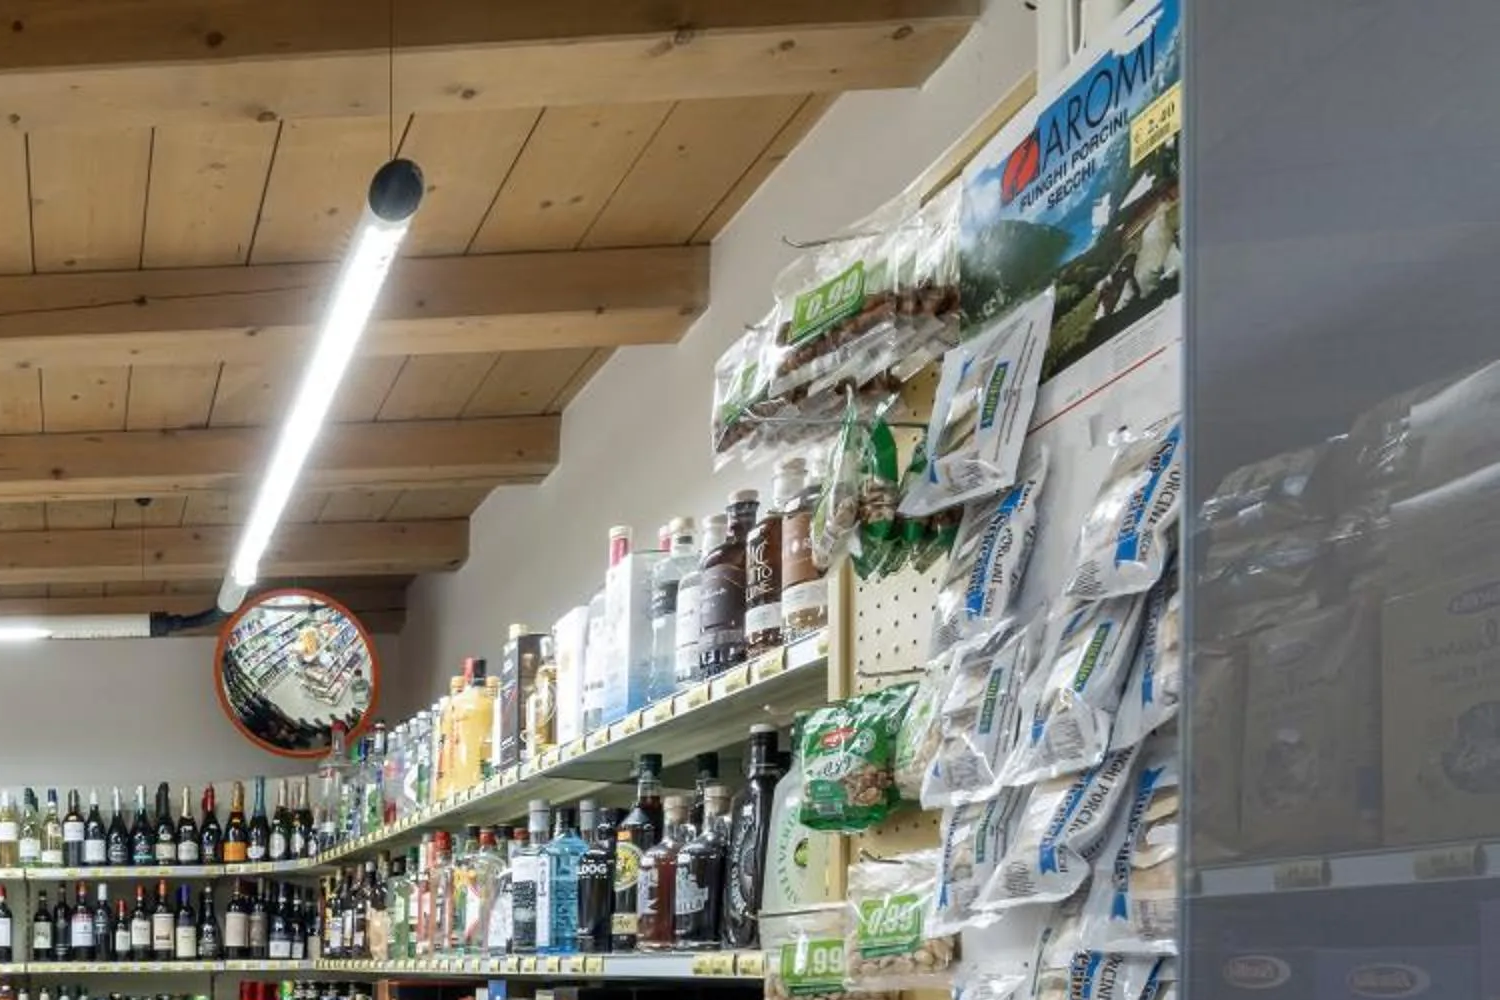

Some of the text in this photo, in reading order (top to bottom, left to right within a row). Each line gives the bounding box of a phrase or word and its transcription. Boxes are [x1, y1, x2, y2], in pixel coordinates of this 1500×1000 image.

[1042, 25, 1157, 176] AROMI
[1019, 108, 1130, 212] FUNGHI PORCINI
[1047, 157, 1097, 210] SECCHI
